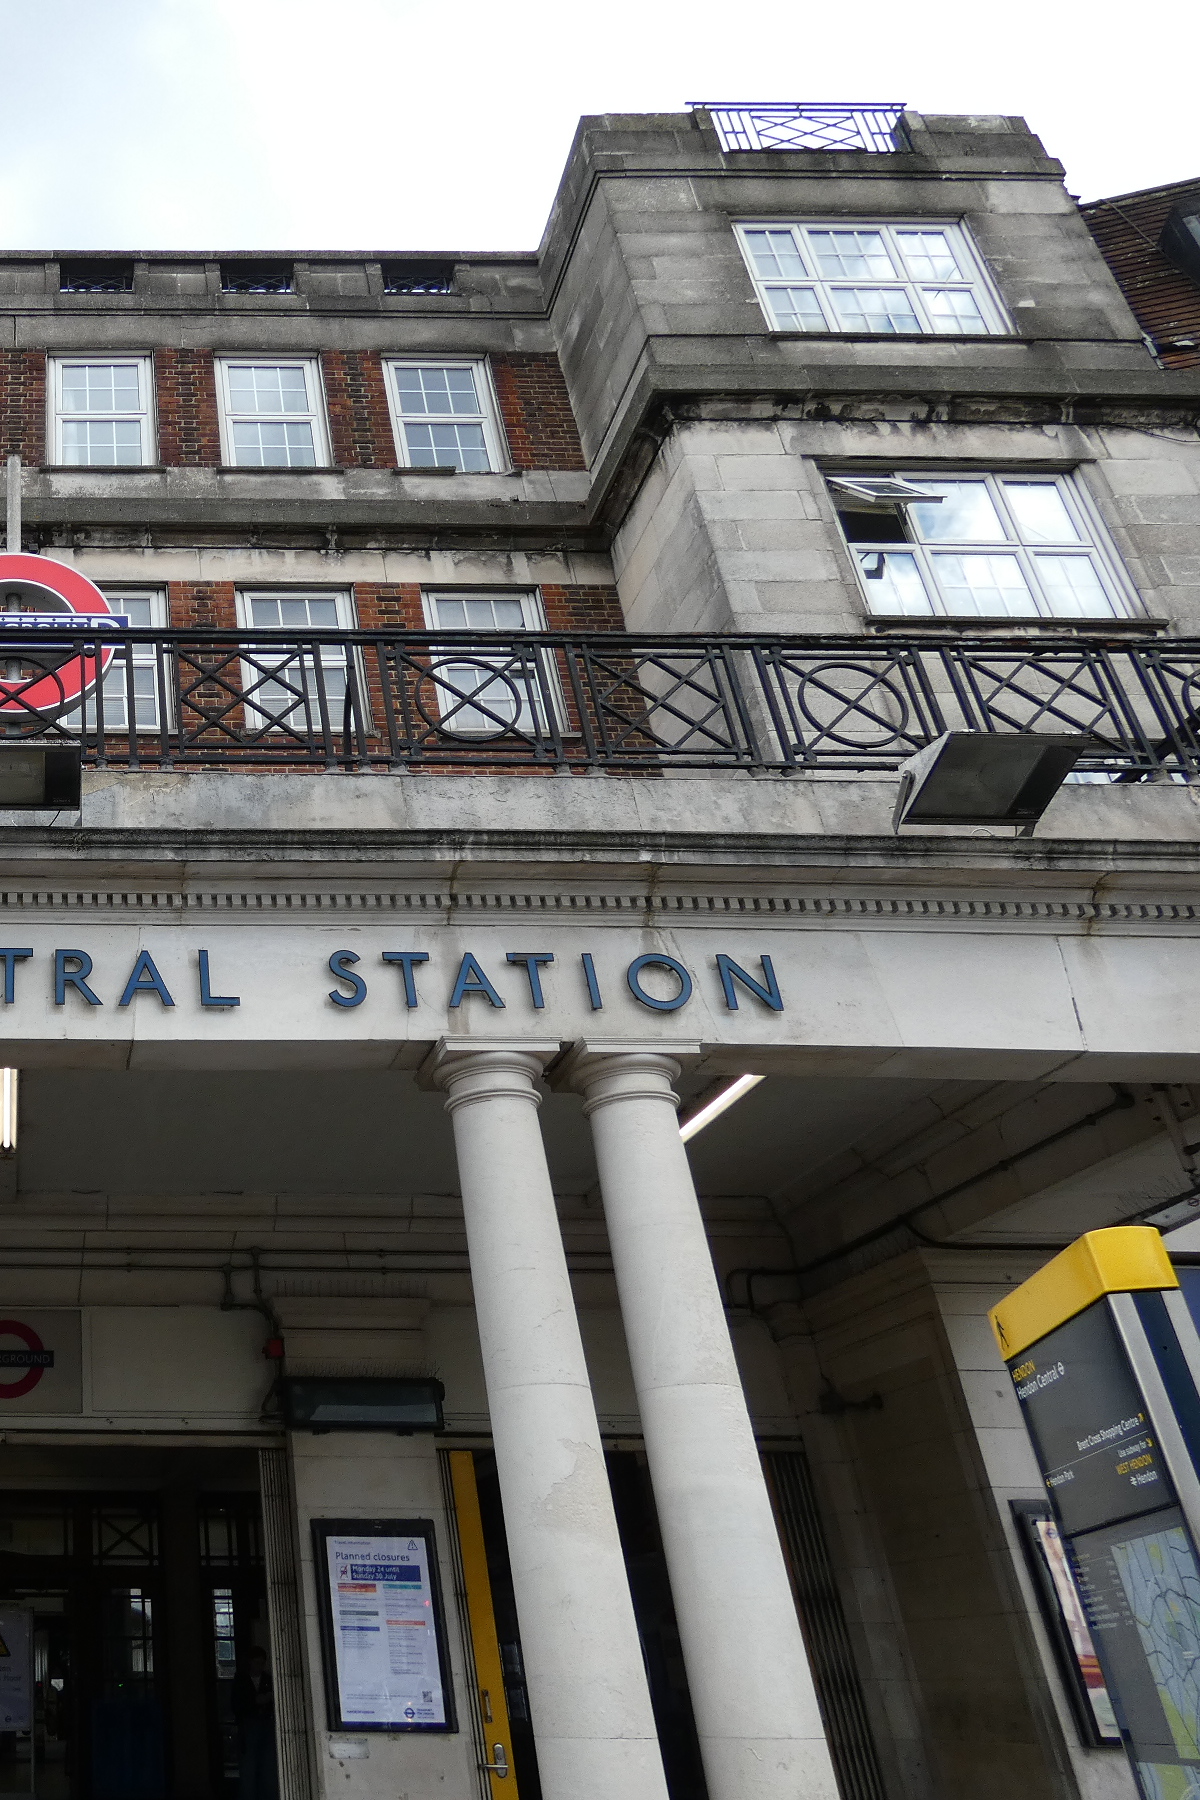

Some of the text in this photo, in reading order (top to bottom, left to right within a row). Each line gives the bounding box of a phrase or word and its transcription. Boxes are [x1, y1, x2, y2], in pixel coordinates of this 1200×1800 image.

[328, 949, 785, 1012] STATION
[1012, 1360, 1036, 1382] HENDON
[1016, 1365, 1059, 1400] Hendon Central
[1076, 1416, 1140, 1451] Brent Cross Shopping Centre
[1115, 1454, 1154, 1475] WEST HENDON
[1136, 1470, 1158, 1485] Hendon
[335, 1551, 410, 1562] Planned closures
[352, 1565, 376, 1573] Monday
[352, 1572, 375, 1580] Sunday
